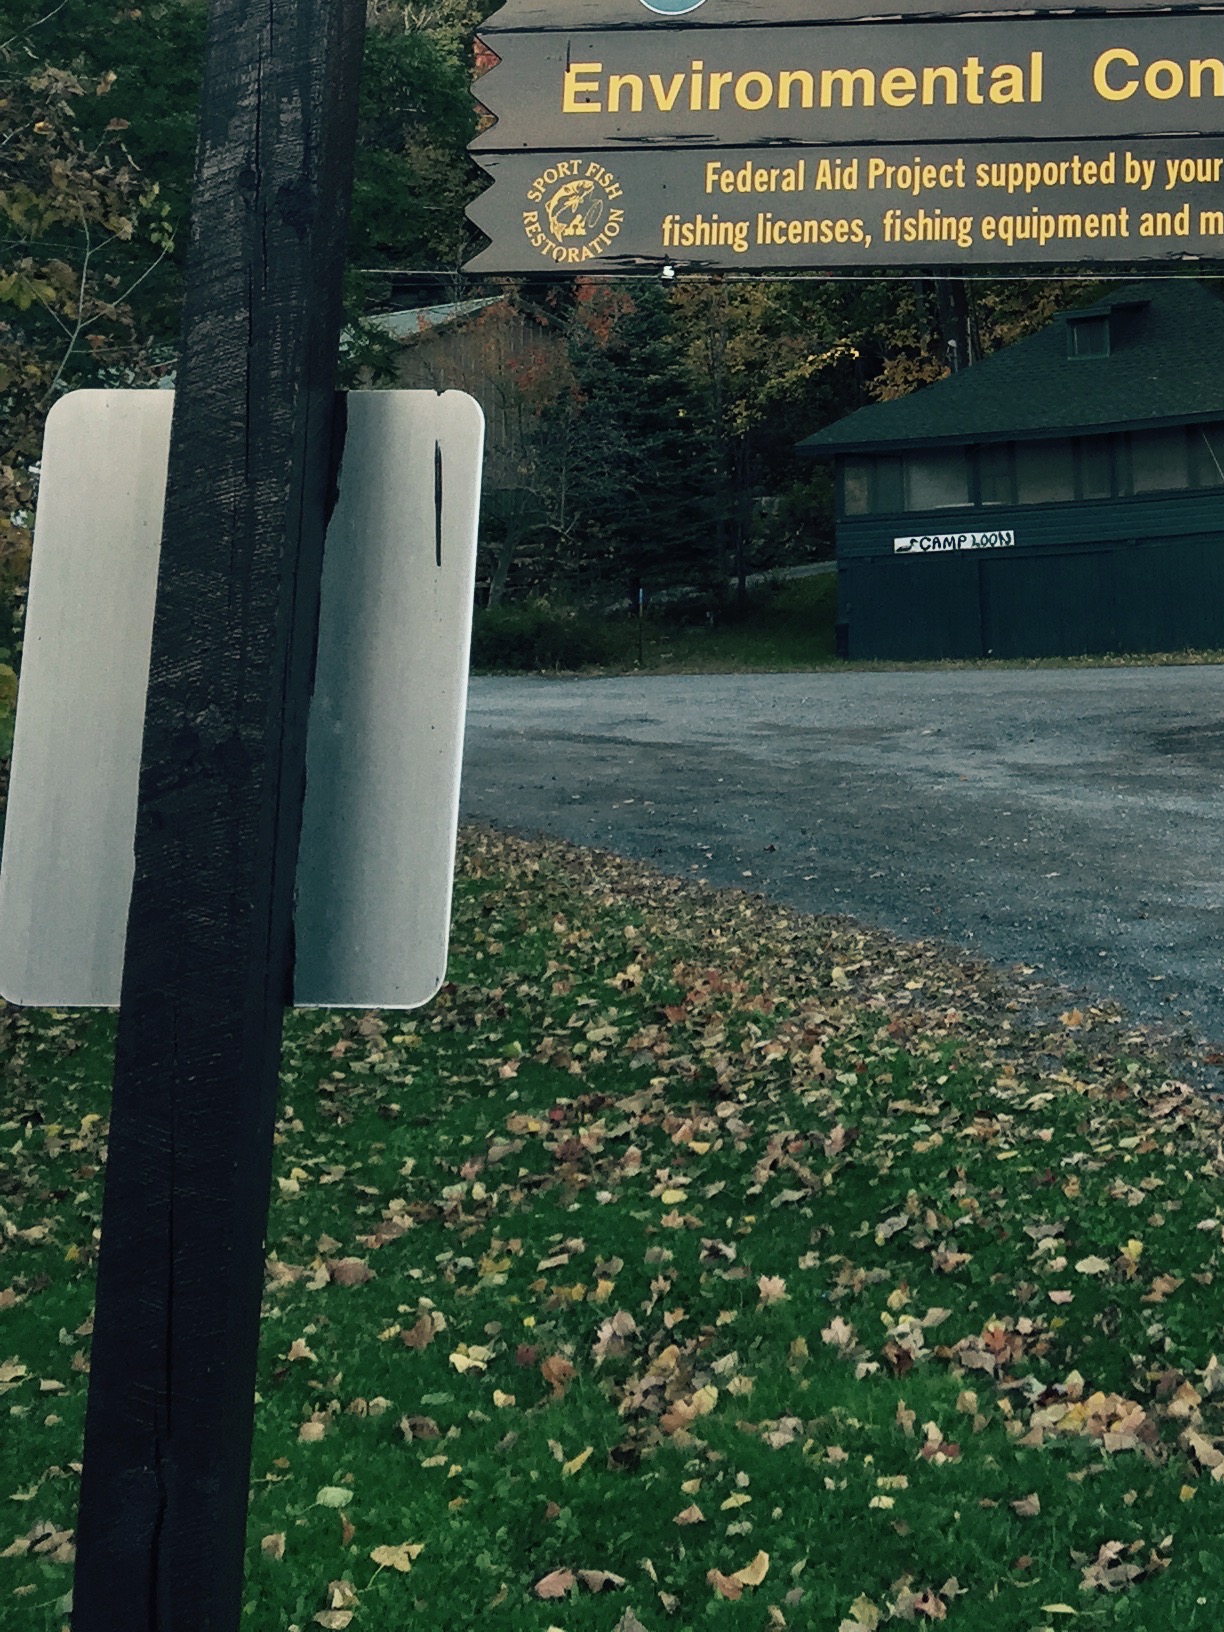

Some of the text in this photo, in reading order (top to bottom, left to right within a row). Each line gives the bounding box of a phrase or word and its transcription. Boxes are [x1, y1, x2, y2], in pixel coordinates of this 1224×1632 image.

[561, 51, 1043, 114] Environmental
[527, 159, 624, 202] SPORT FISH
[705, 159, 805, 193] Federal
[815, 159, 859, 191] Aid
[867, 157, 965, 196] Project
[975, 152, 1116, 193] supported
[1124, 152, 1155, 191] by
[1165, 158, 1223, 190] your
[522, 208, 625, 263] RESTORATION
[662, 214, 748, 253] fishing
[756, 213, 871, 247] licenses,
[882, 209, 973, 248] fishing
[981, 207, 1129, 247] equipment
[1139, 204, 1190, 237] and
[919, 531, 1012, 552] CAMP LOON
